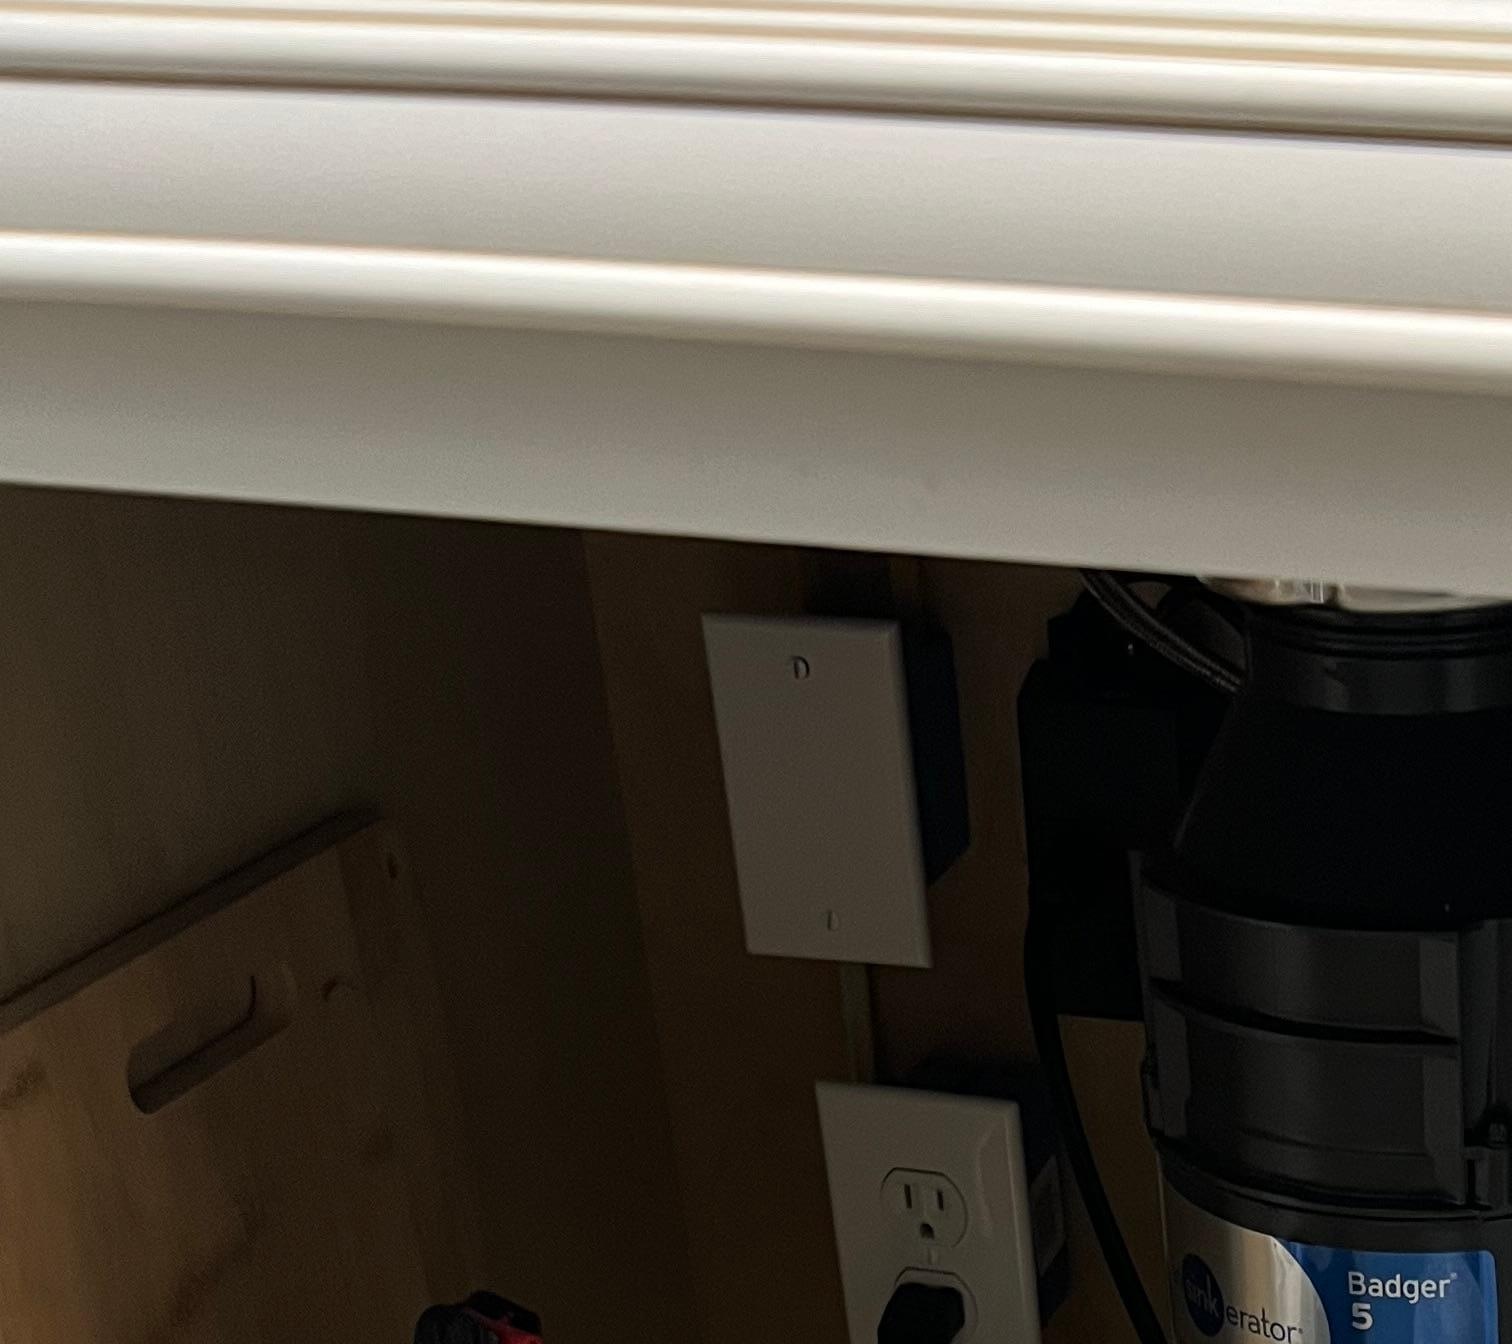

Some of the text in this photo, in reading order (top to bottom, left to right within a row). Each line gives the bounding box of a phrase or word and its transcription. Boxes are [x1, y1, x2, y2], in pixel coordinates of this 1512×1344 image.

[1347, 1271, 1451, 1304] Badger
[1226, 1306, 1298, 1344] erator
[1352, 1302, 1374, 1331] 5
